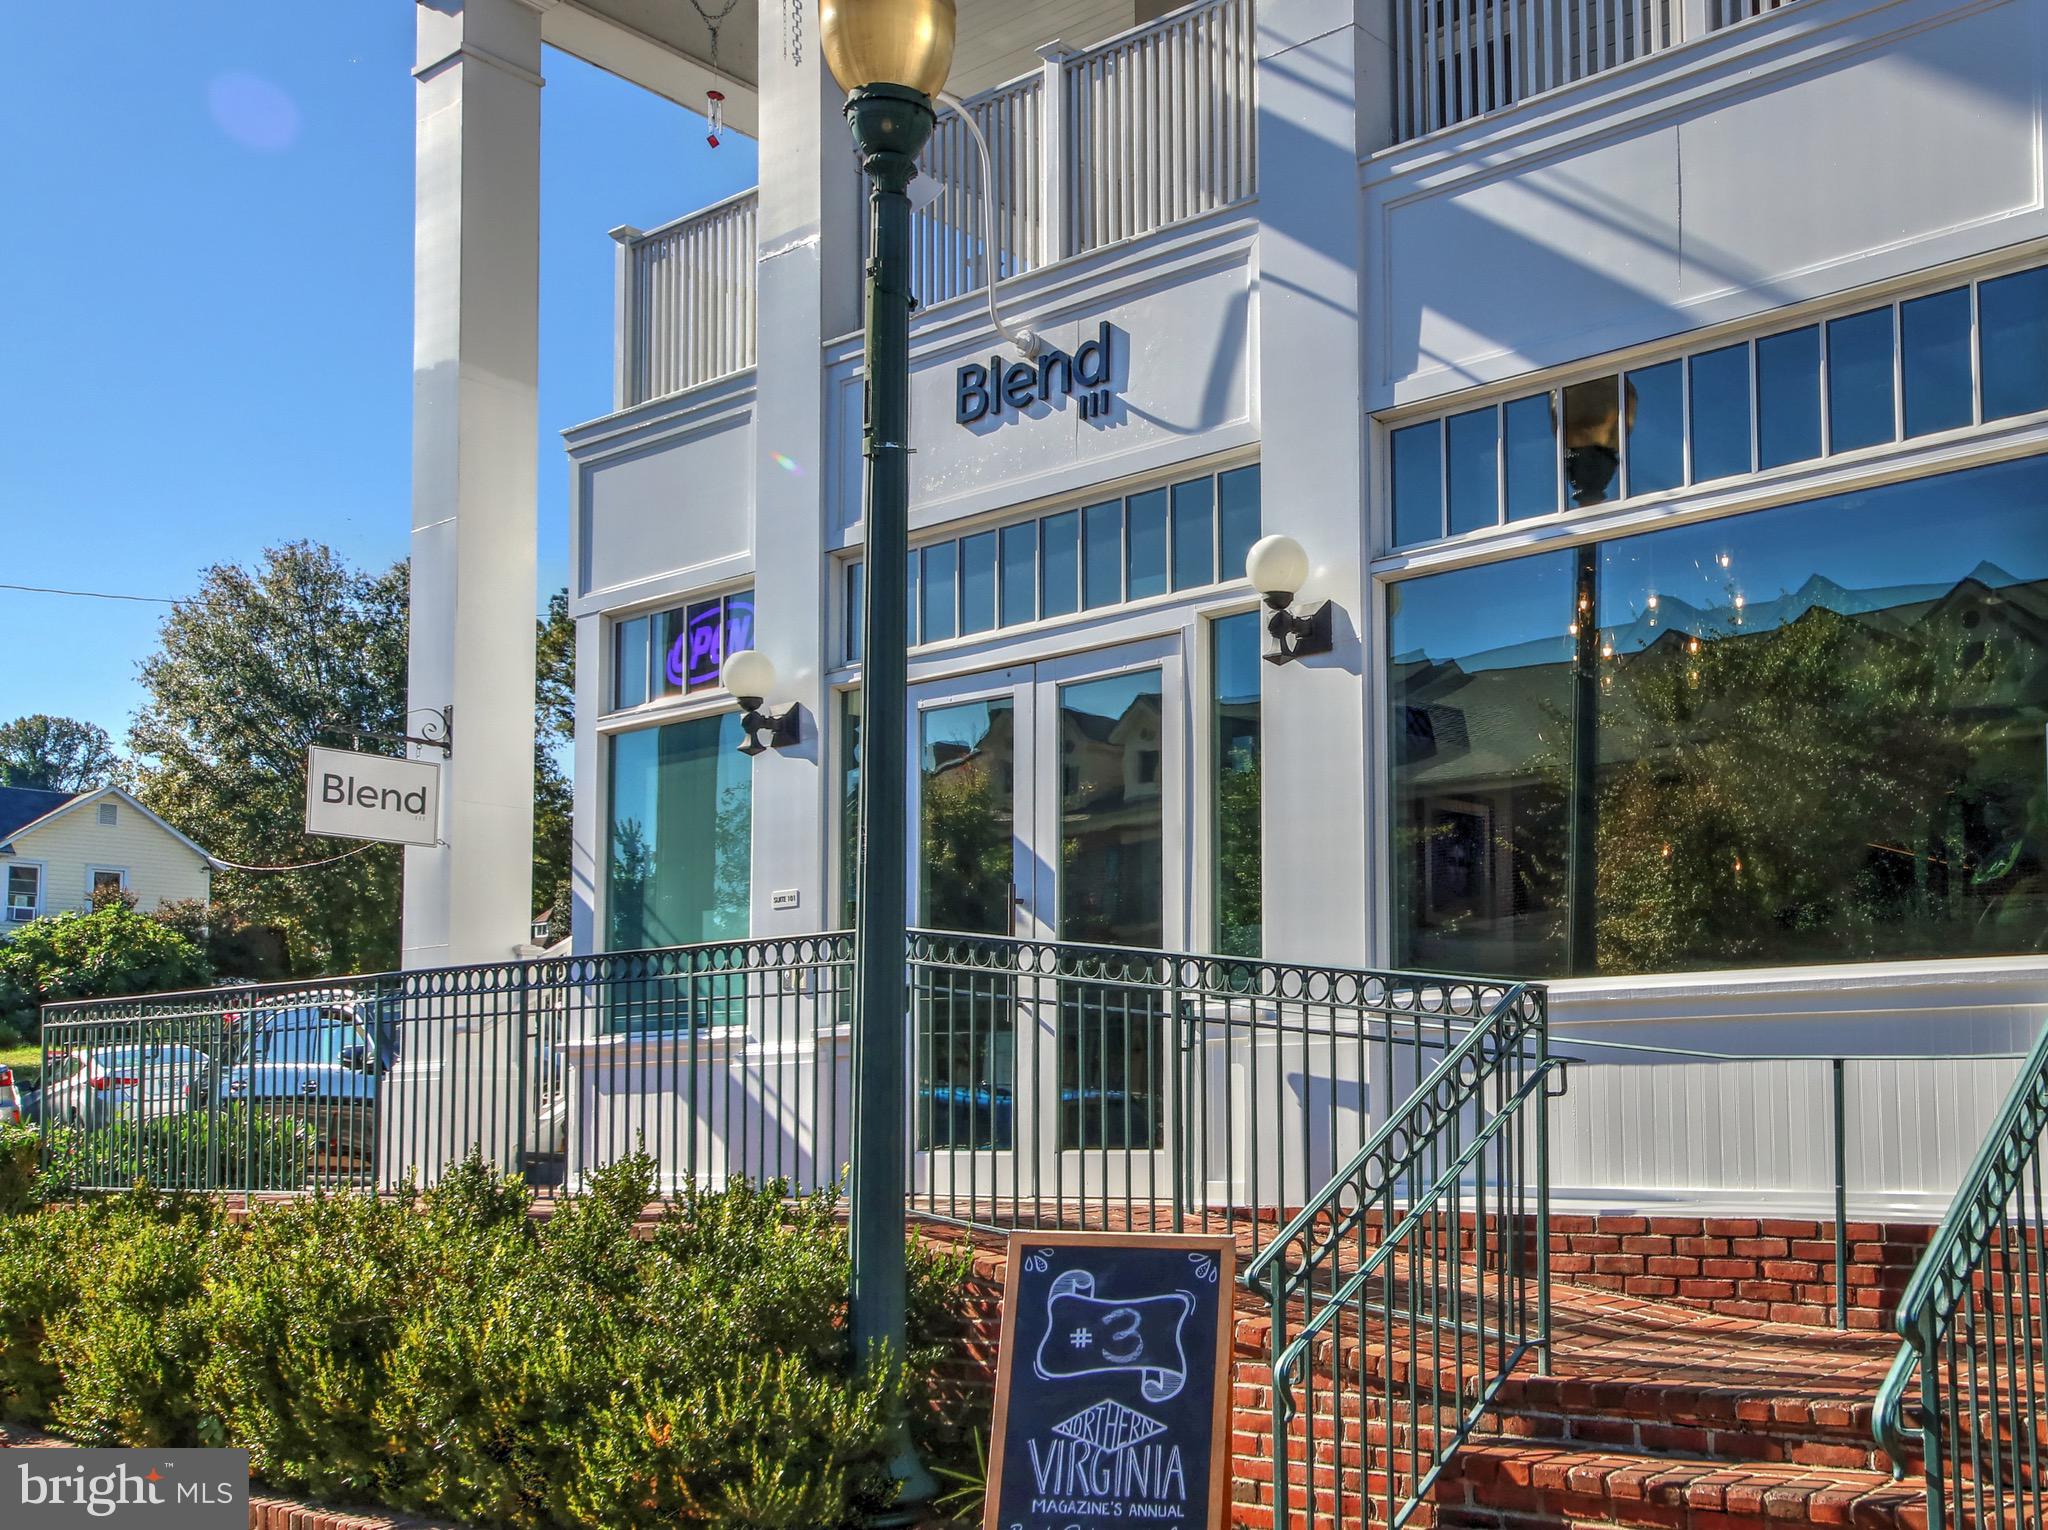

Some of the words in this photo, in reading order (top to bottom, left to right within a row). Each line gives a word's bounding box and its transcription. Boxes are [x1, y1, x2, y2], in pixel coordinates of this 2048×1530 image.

[956, 320, 1111, 424] Blend
[322, 773, 427, 815] Blend
[1060, 1404, 1156, 1449] NORTHERN
[1028, 1439, 1186, 1500] VIRGINIA
[1031, 1500, 1122, 1517] MAGAZINE'S
[1129, 1503, 1184, 1518] ANNUAL
